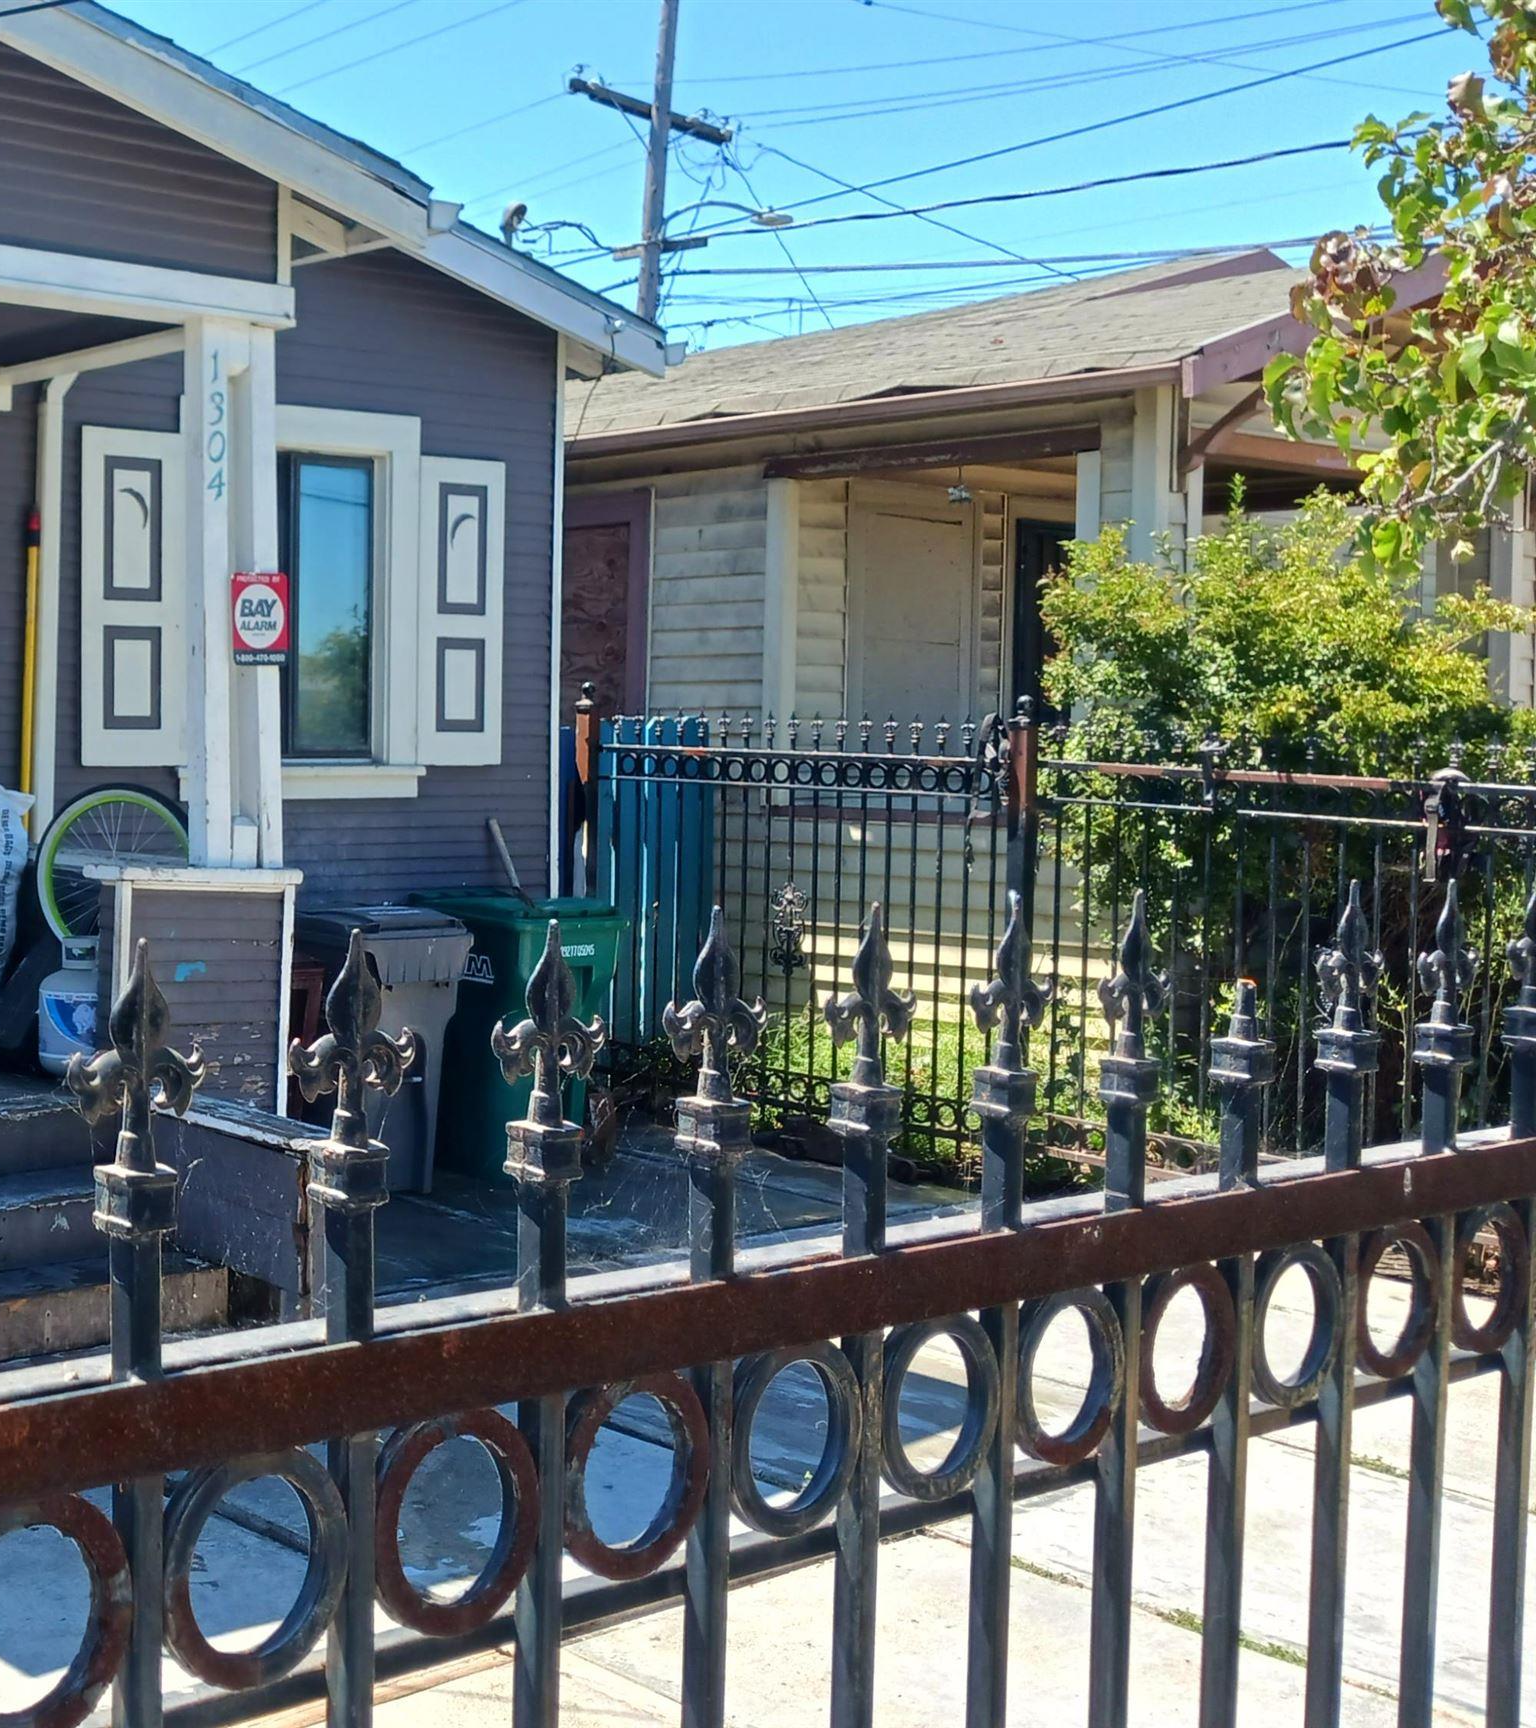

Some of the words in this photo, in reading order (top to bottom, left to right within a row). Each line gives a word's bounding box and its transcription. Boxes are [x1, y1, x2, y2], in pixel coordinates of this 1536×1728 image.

[206, 351, 226, 501] 1304
[240, 598, 278, 617] BAY
[240, 620, 277, 631] ALARM
